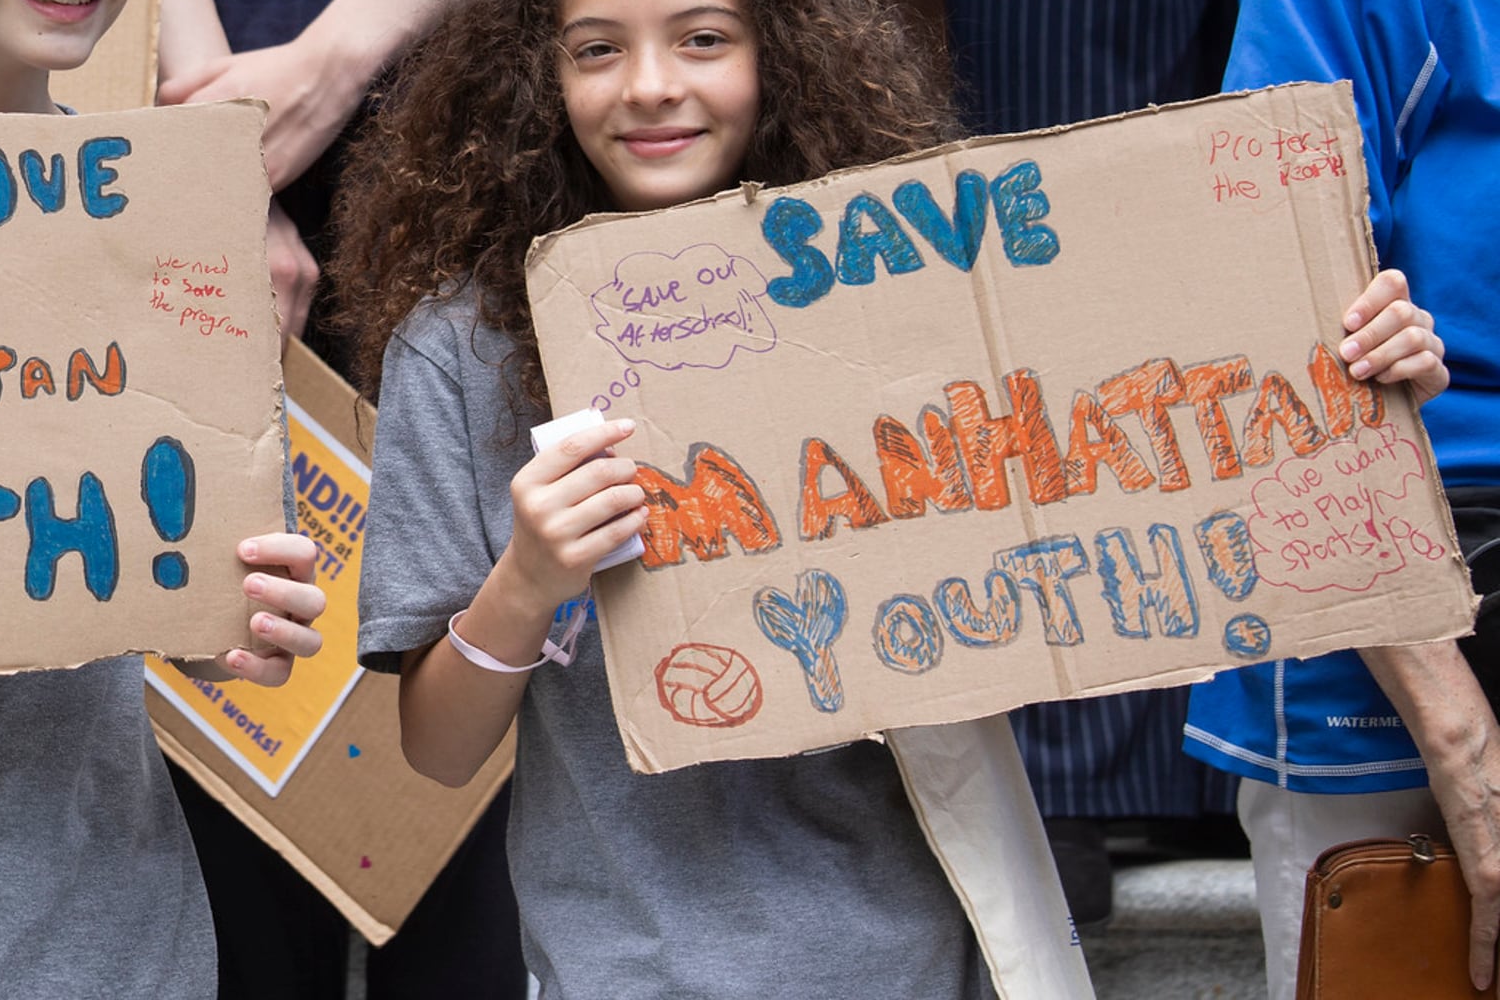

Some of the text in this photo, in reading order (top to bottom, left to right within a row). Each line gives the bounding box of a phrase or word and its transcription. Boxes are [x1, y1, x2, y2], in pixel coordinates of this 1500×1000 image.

[1213, 171, 1261, 203] the
[760, 157, 1061, 309] SAVE
[153, 271, 171, 286] to
[192, 254, 229, 274] need
[149, 289, 248, 339] the program
[634, 342, 1386, 572] MANHATTAN
[1282, 440, 1398, 498] we want
[296, 500, 354, 562] Stays at
[1273, 510, 1309, 531] to
[753, 511, 1272, 715] YOUTH!
[222, 699, 283, 757] works!
[1327, 716, 1403, 728] WATERME
